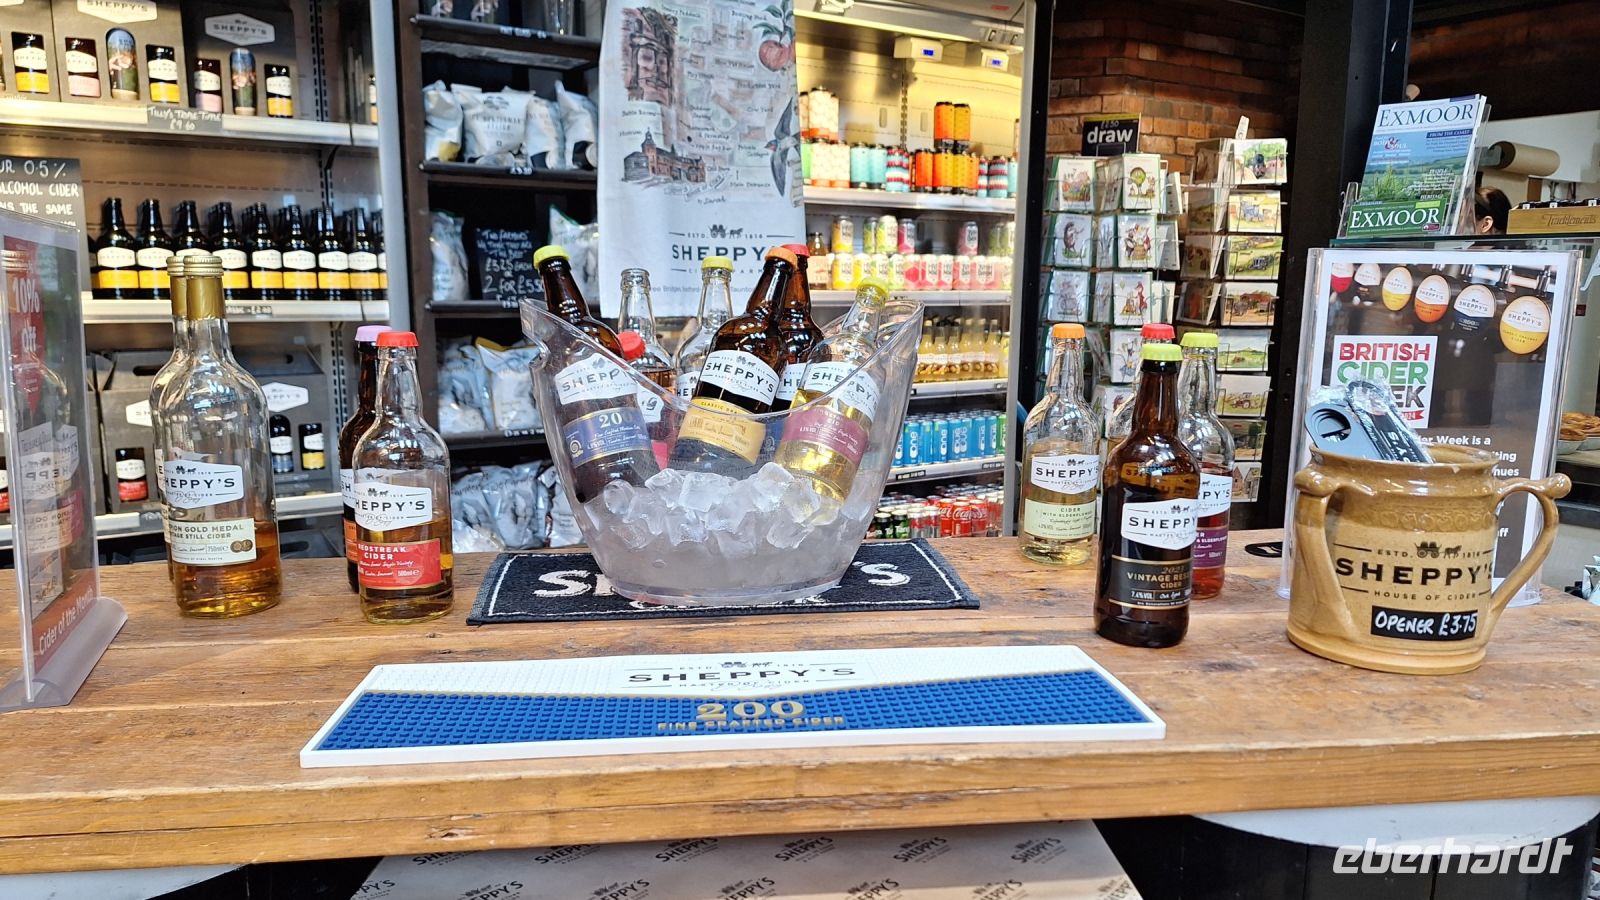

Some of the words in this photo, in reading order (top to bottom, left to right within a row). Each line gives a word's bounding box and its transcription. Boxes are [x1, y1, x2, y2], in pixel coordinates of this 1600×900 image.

[213, 23, 267, 34] SHEPPY'S
[1378, 104, 1473, 127] EXMOOR
[1087, 126, 1133, 143] draw
[48, 183, 79, 197] CIDER
[20, 202, 38, 214] THE
[45, 203, 73, 215] SAME
[1350, 207, 1439, 229] EXMOOR
[482, 275, 497, 293] 2
[12, 277, 40, 313] 10%
[1459, 301, 1488, 312] SHEPPY'S
[1508, 313, 1542, 327] SHEPPY'S
[1339, 342, 1430, 361] BRITISH
[705, 362, 774, 393] SHEPPY'S
[1337, 361, 1429, 385] CIDER
[1391, 385, 1426, 408] EK
[1436, 435, 1469, 445] Week
[1472, 435, 1481, 445] is
[211, 524, 244, 532] MEDAL
[364, 552, 393, 560] CIDER
[1377, 549, 1414, 558] ESTD.
[1127, 572, 1171, 581] VINTAGE
[1374, 591, 1417, 600] HOUSE
[39, 625, 57, 656] Cider
[58, 615, 66, 635] of
[65, 608, 76, 627] the
[1375, 611, 1434, 635] OPENER
[1438, 613, 1478, 636] £3.75
[629, 668, 855, 682] SHEPPY'S
[696, 700, 804, 720] 200
[658, 721, 696, 731] FINE
[704, 718, 785, 729] CRAFTED
[793, 716, 844, 726] CIDER
[775, 836, 833, 862] SHEPPY'S
[894, 836, 947, 863] SHEPPY'S
[1011, 837, 1061, 863] SHEPPY'S
